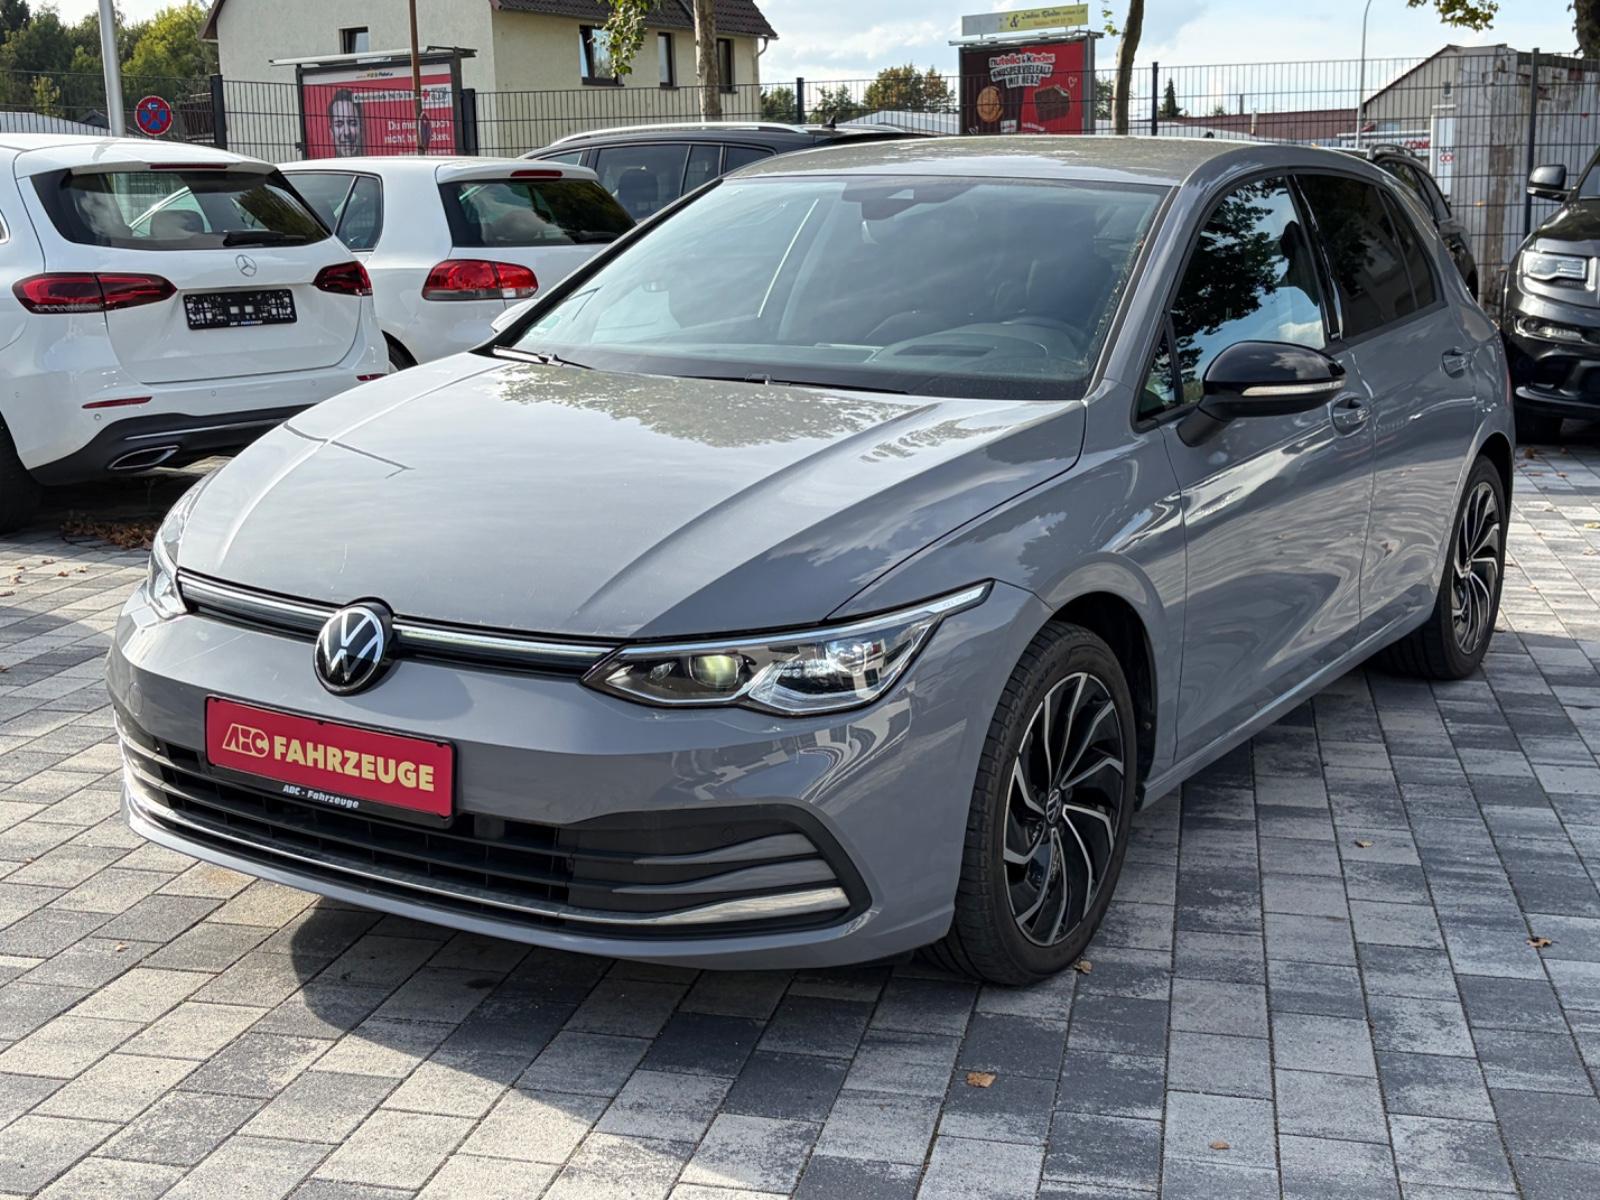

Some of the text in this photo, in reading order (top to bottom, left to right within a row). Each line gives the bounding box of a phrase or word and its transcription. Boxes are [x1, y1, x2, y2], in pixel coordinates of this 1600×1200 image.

[990, 55, 1021, 66] nutella
[273, 735, 435, 792] FAHRZEUGE
[283, 784, 300, 796] ABC
[307, 790, 359, 809] Fahrzeuge
